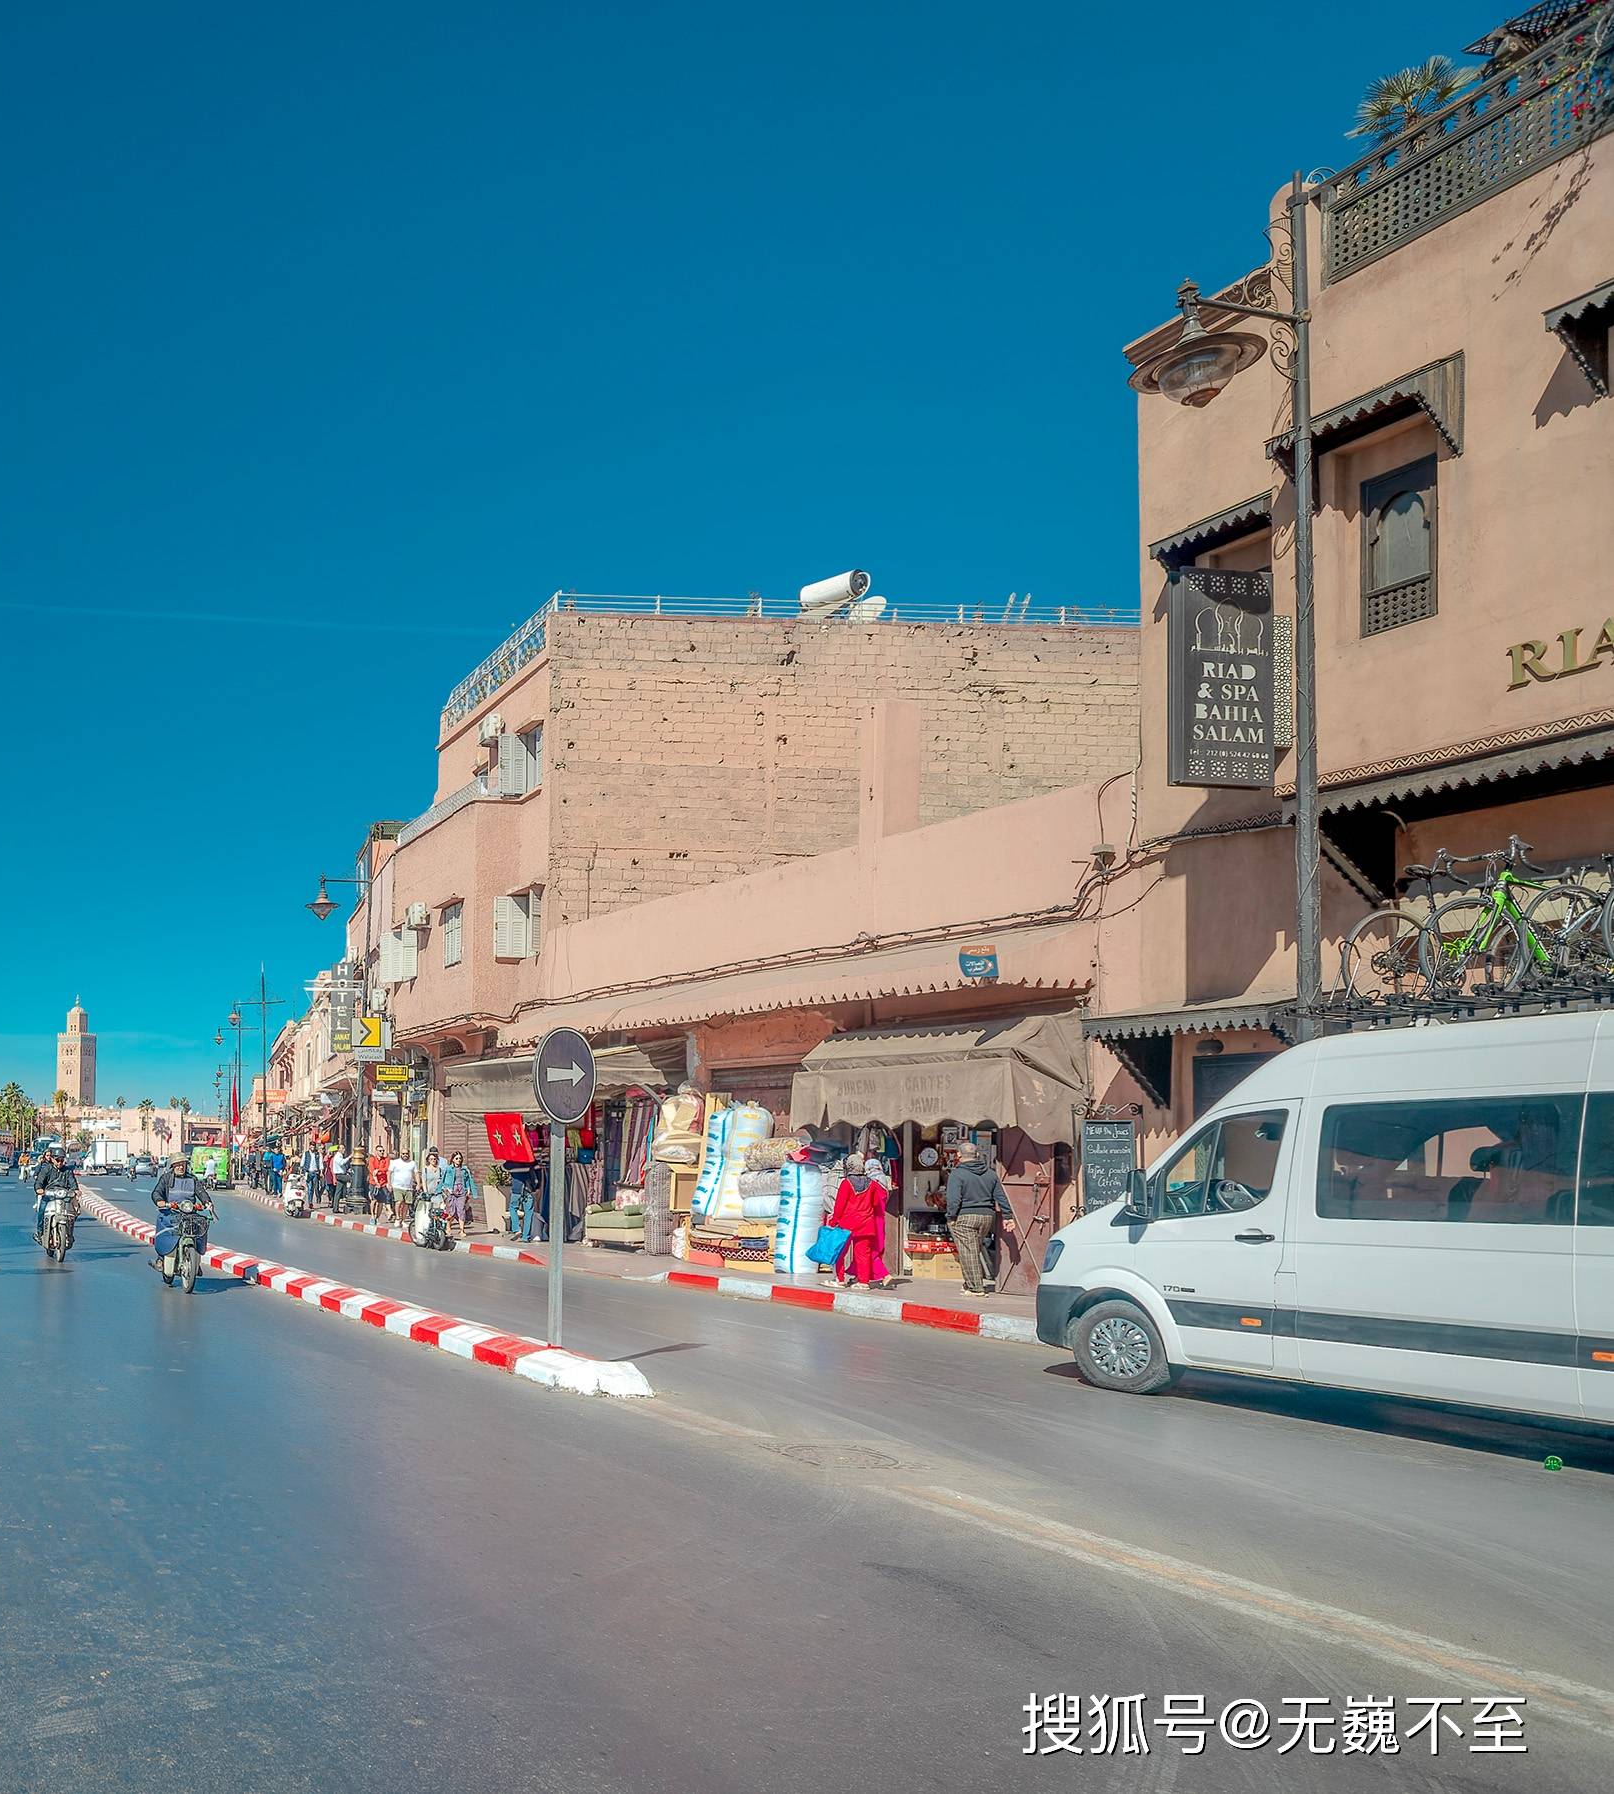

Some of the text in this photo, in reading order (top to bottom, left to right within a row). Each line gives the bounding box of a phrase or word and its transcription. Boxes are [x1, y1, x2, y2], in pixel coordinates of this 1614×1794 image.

[1202, 661, 1257, 681] RIAD
[1197, 682, 1259, 702] & SPA
[1194, 703, 1264, 723] BAHIA
[1193, 724, 1265, 744] SALAM
[337, 964, 350, 1031] HOTEL
[1163, 1284, 1180, 1292] 170
